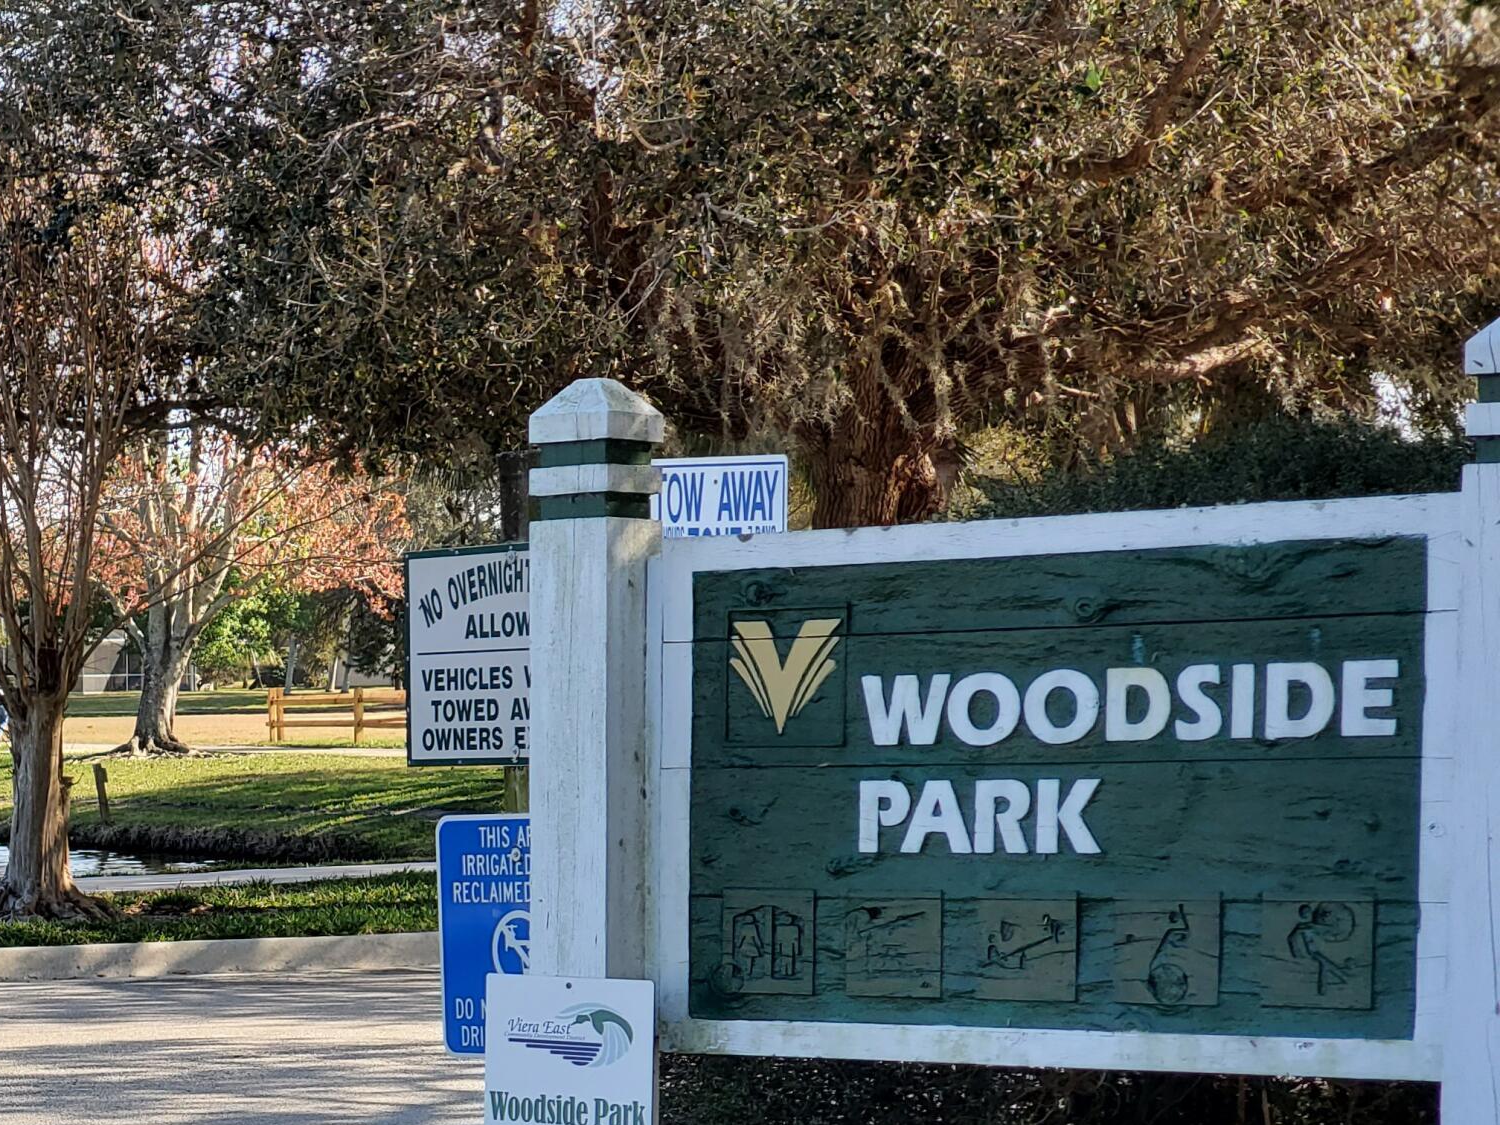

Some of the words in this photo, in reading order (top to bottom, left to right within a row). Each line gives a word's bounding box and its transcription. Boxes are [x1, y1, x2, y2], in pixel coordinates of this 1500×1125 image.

[717, 470, 779, 521] AWAY
[418, 587, 443, 628] NO
[421, 665, 513, 692] VEHICLES
[431, 698, 500, 723] TOWED
[861, 659, 1399, 747] WOODSIDE
[422, 726, 504, 751] OWNERS
[858, 778, 1102, 855] PARK
[478, 825, 510, 848] THIS
[462, 853, 531, 876] IRRIGATED
[453, 881, 532, 904] RECLAIMED
[455, 997, 474, 1020] DO
[508, 1016, 540, 1033] Viera
[543, 1021, 572, 1035] East
[489, 1090, 588, 1125] Woodside
